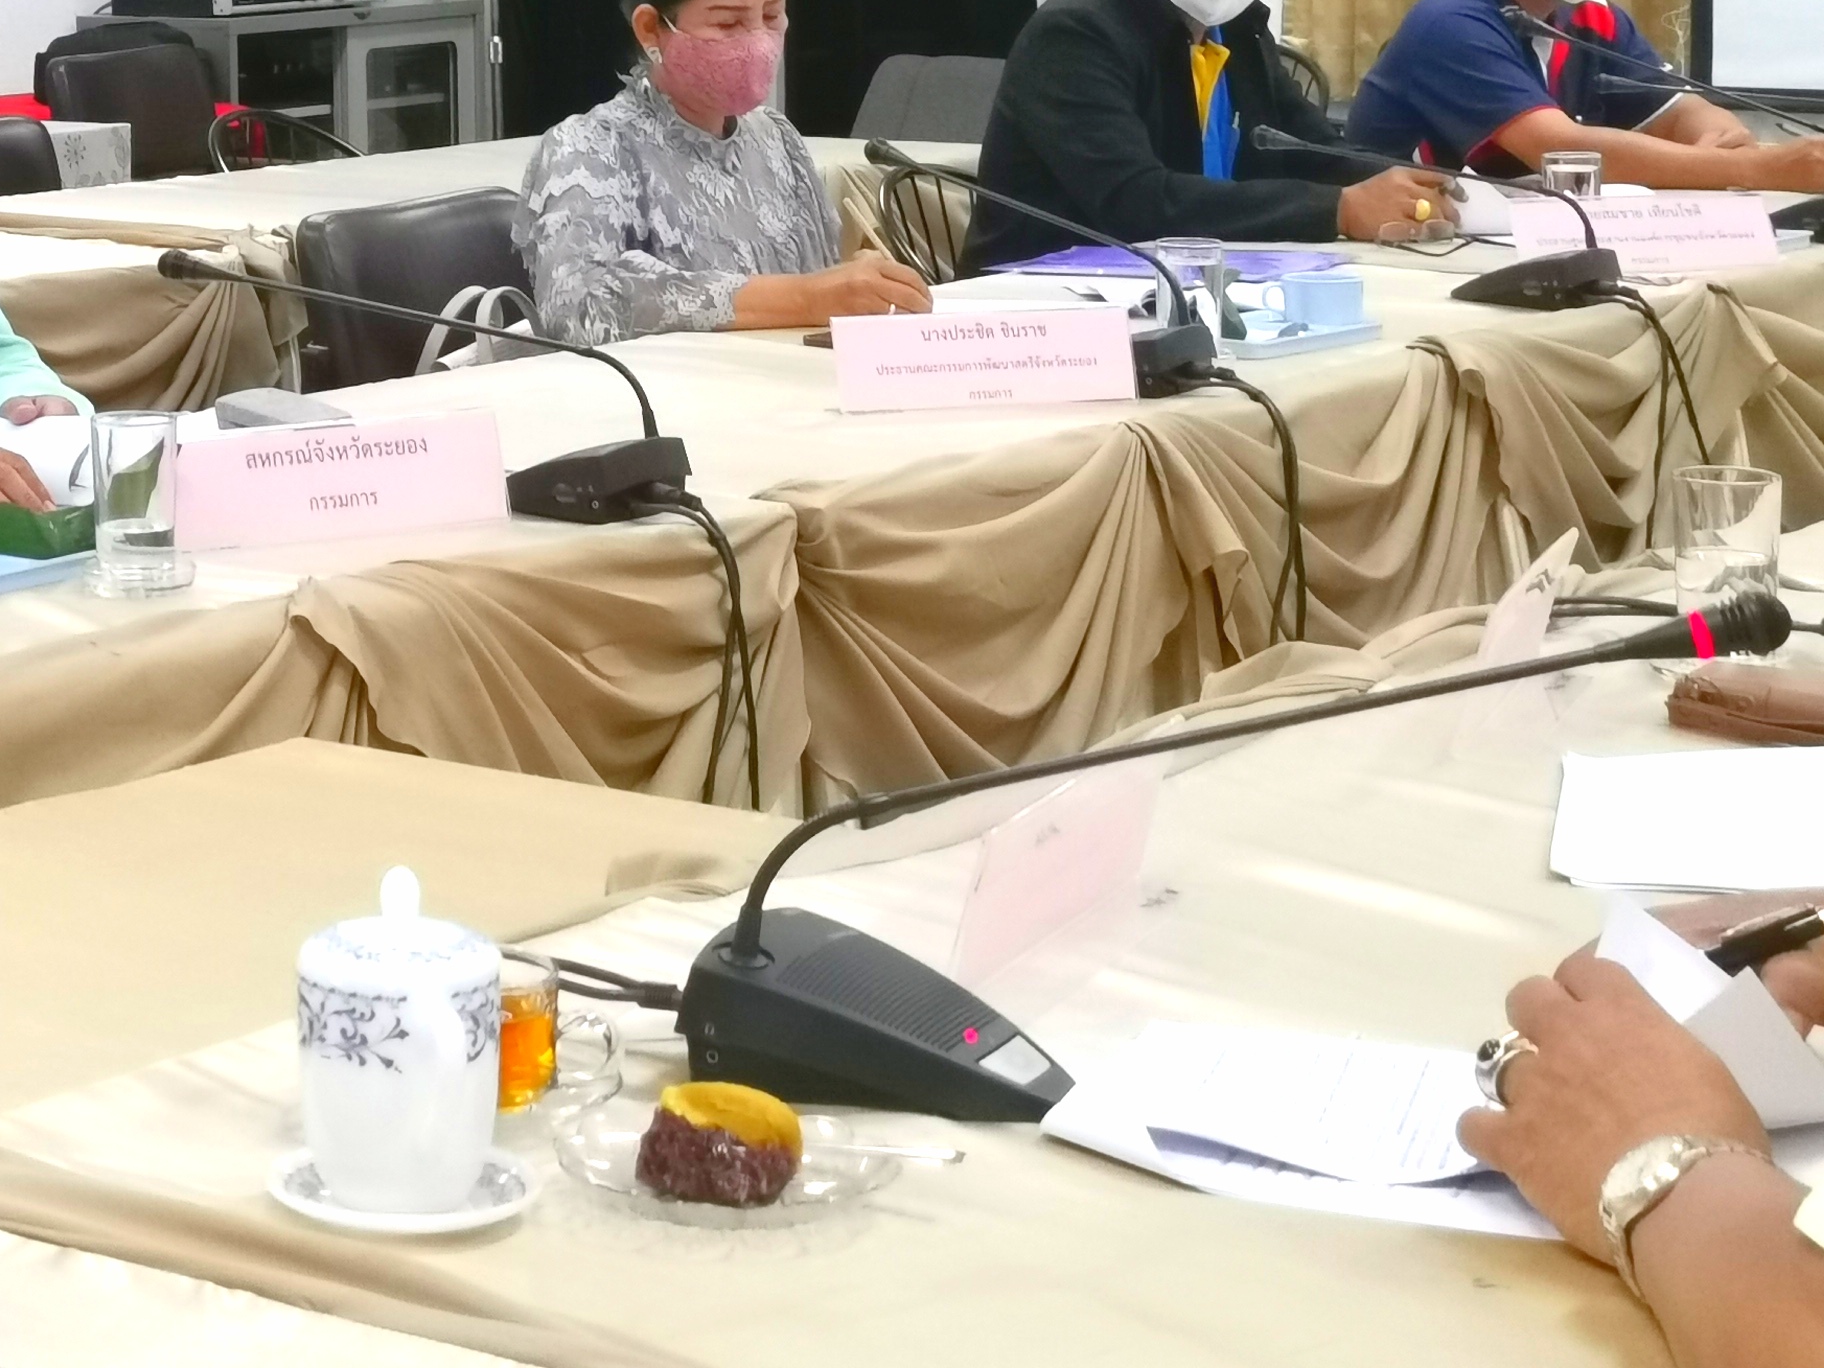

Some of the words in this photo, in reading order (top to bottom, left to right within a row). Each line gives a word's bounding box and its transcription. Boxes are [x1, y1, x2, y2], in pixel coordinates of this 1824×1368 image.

[969, 388, 1013, 401] กรรมการ
[245, 435, 429, 470] สหกรณ์จังหวัดระยอง
[309, 490, 379, 512] กรรมการ
